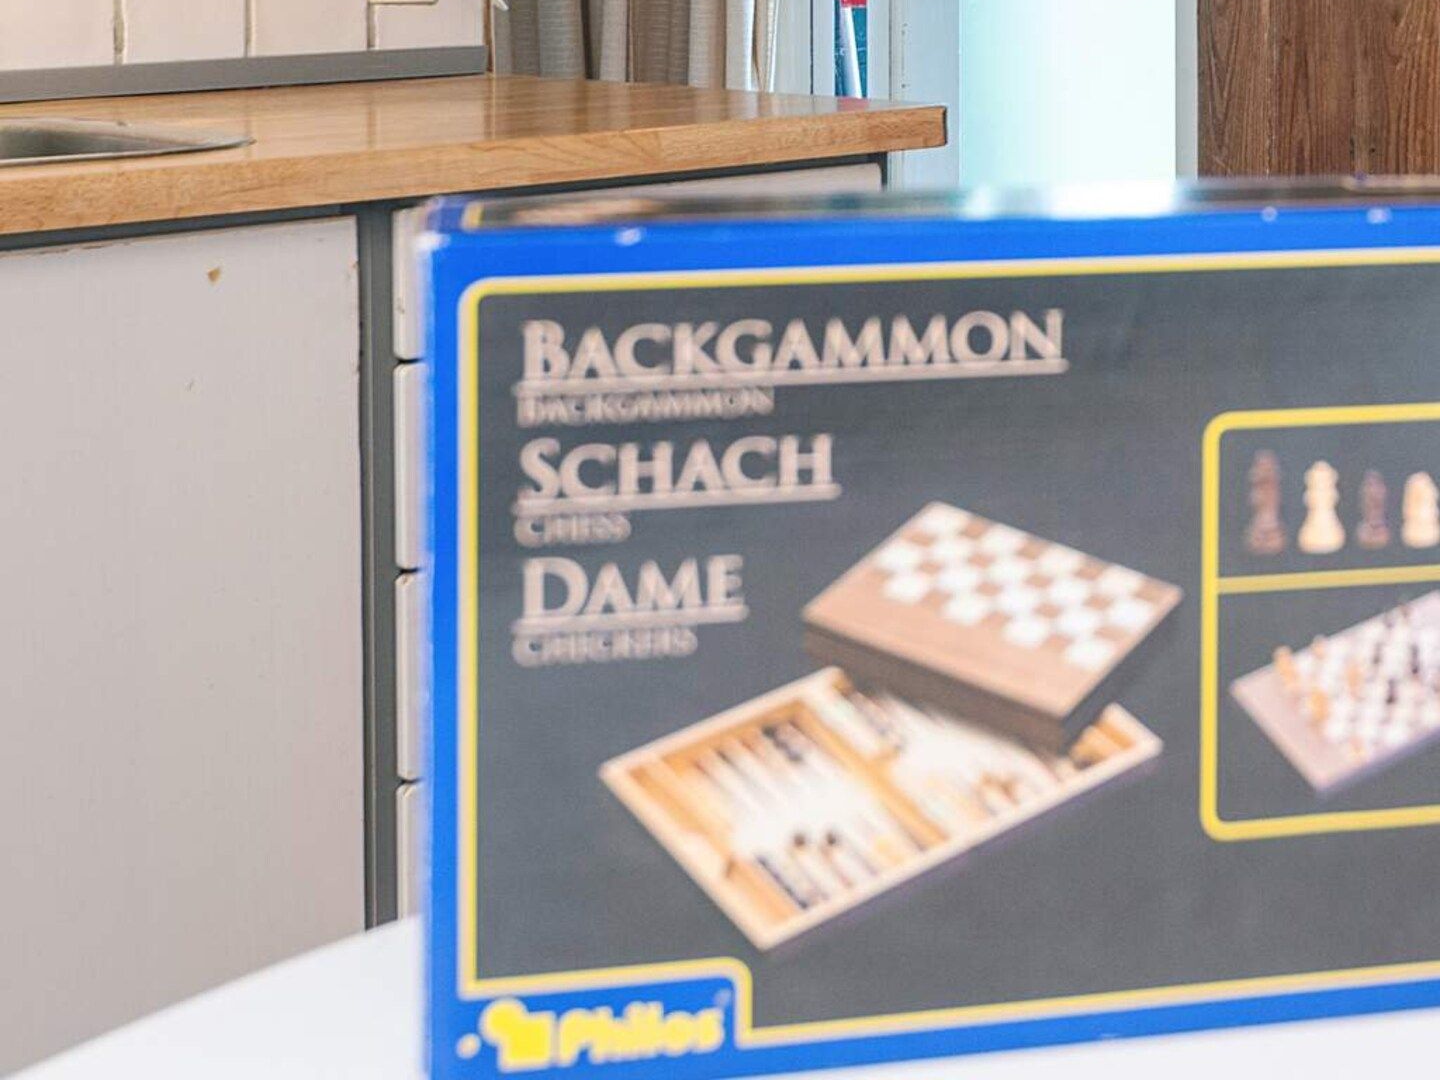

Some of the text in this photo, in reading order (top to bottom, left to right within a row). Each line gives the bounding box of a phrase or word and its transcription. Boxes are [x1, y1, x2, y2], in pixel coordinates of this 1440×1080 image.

[520, 308, 1066, 381] BACKGAMMON
[518, 432, 836, 500] SCHACH
[521, 554, 746, 620] DAME
